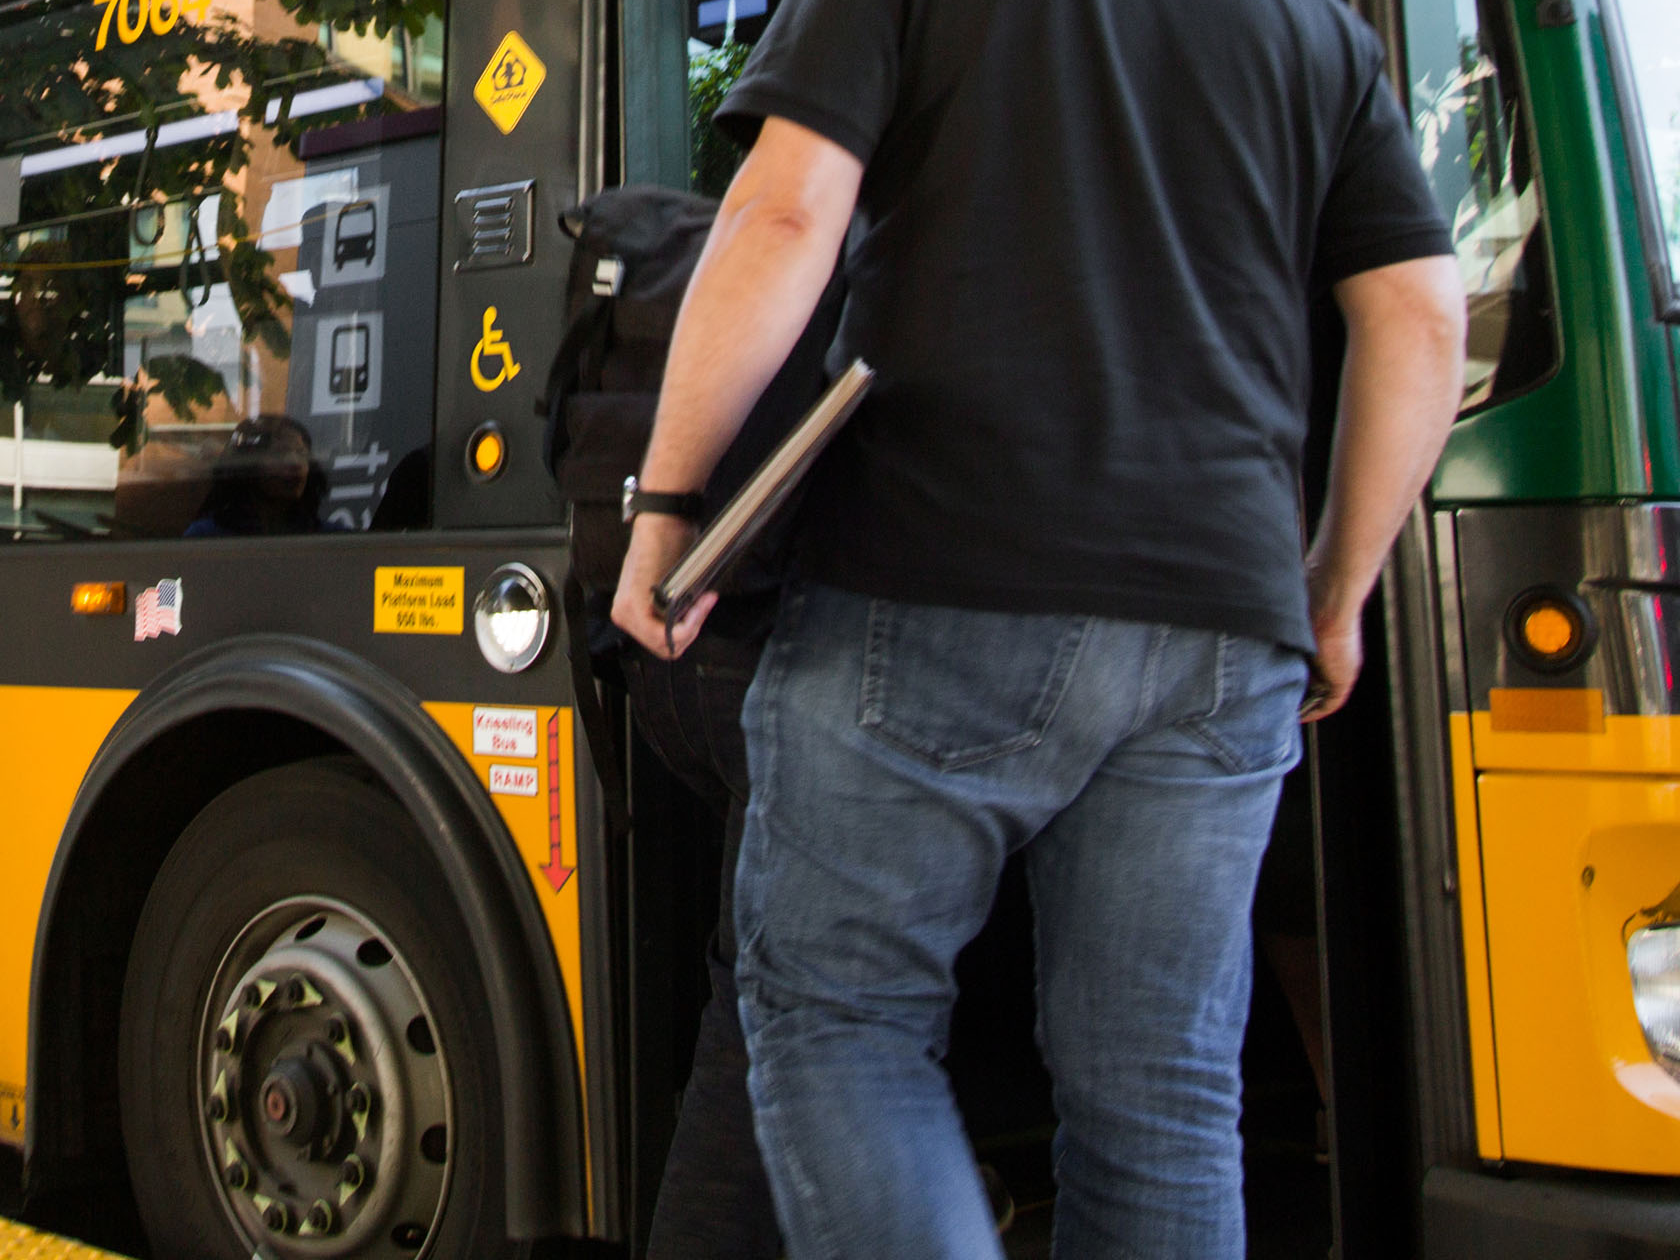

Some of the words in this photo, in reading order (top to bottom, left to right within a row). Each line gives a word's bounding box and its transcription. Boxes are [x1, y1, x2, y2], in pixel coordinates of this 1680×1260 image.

[392, 572, 444, 588] Maximum
[381, 591, 427, 608] Platform
[429, 591, 456, 608] Load
[476, 713, 533, 736] Kneeling
[492, 733, 517, 751] Bus
[493, 769, 535, 789] RAMP
